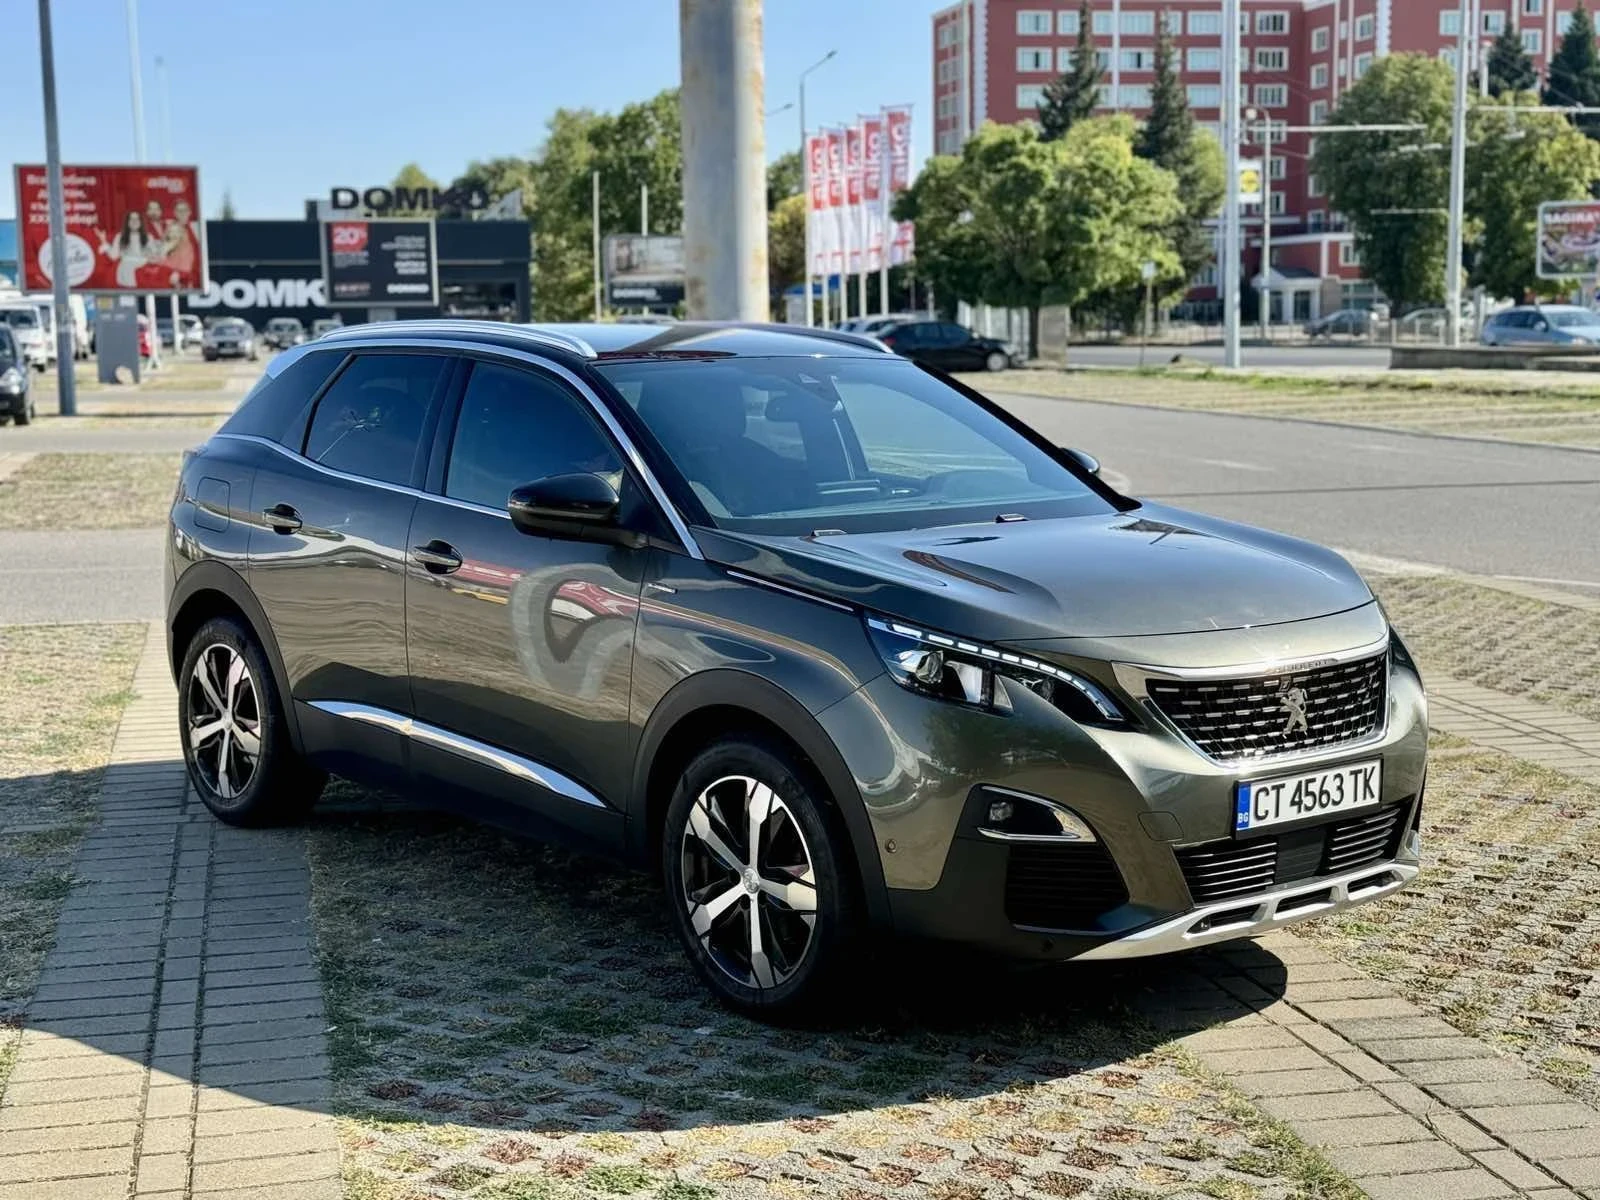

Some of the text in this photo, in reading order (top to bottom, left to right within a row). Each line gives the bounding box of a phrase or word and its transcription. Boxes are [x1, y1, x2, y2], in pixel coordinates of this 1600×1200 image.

[331, 187, 489, 210] DOMKO
[187, 279, 326, 308] DOMK
[1254, 766, 1376, 821] CT 4563 TK
[1237, 812, 1249, 823] BG
